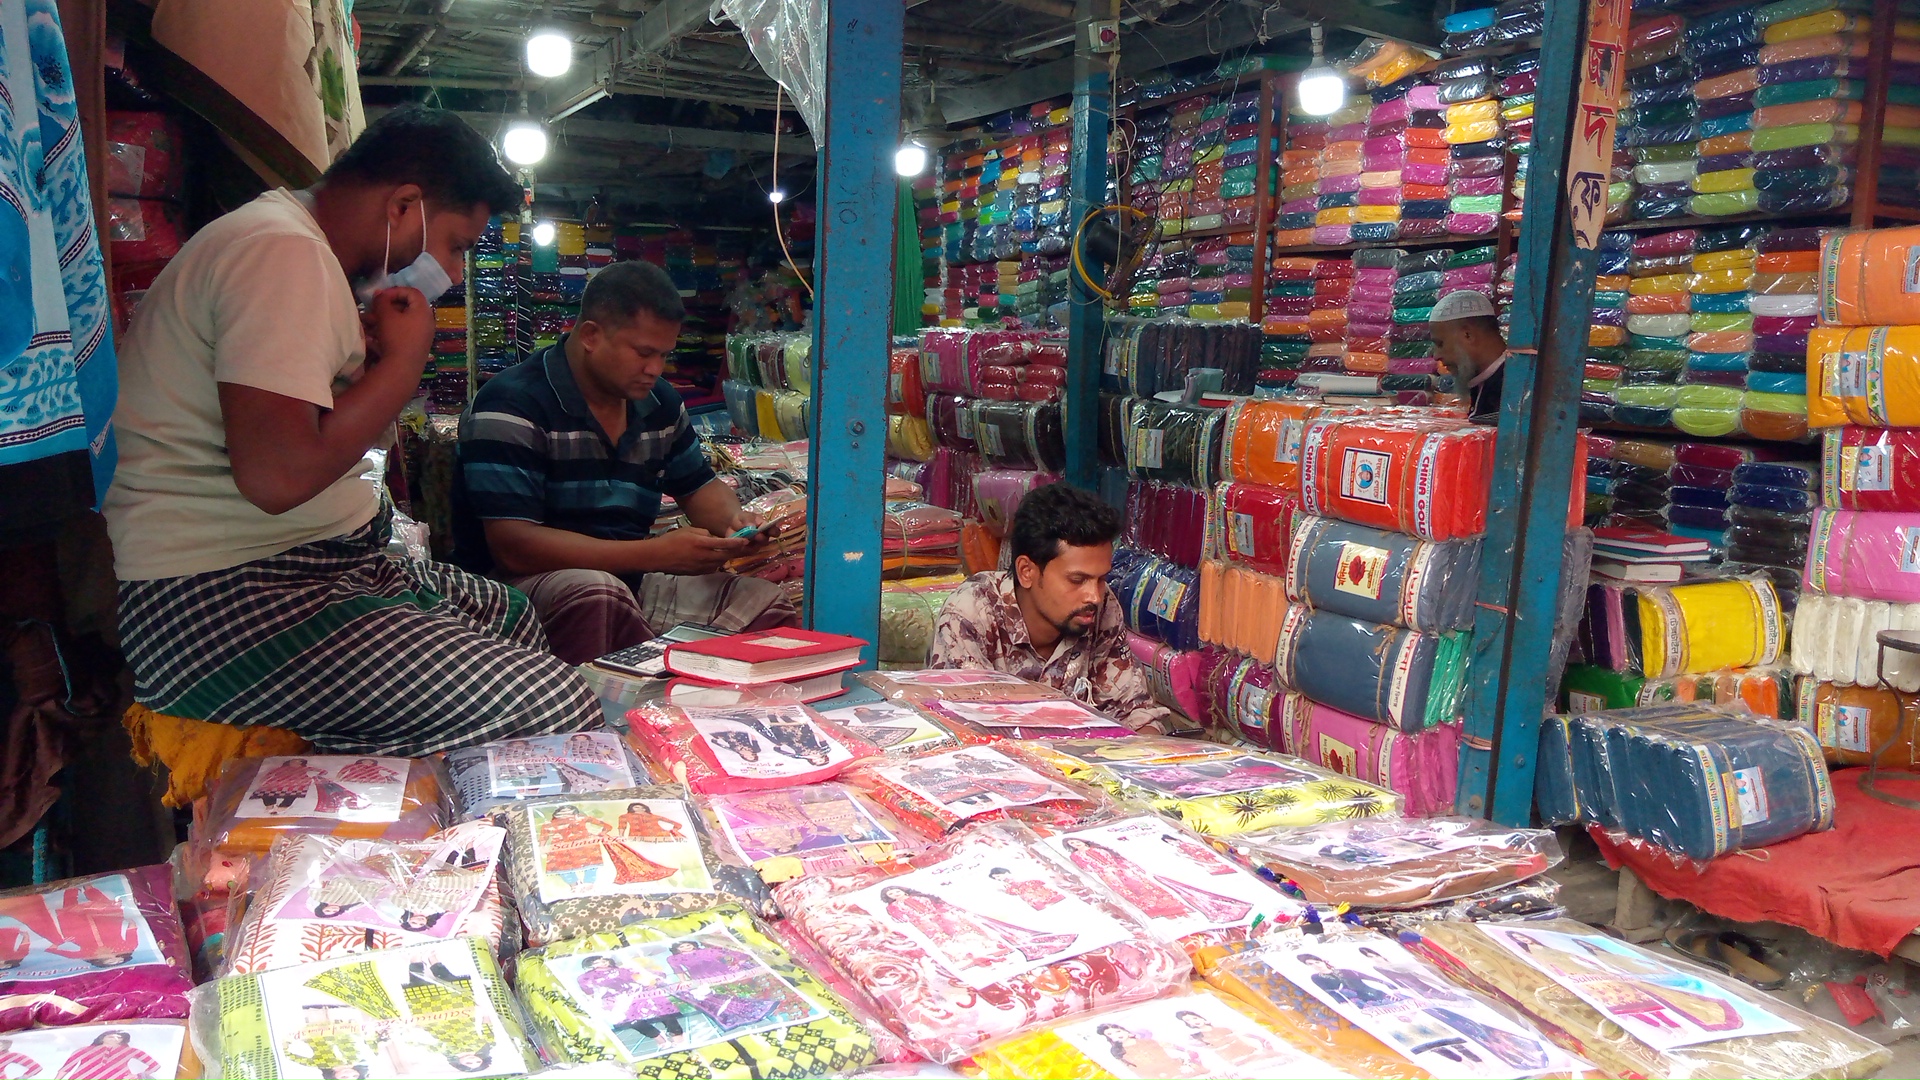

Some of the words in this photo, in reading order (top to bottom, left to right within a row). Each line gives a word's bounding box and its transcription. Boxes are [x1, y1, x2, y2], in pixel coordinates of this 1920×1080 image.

[1305, 445, 1314, 481] CHINA
[1417, 456, 1430, 496] CHINA
[1417, 500, 1426, 536] GOLD
[551, 836, 604, 852] Salman
